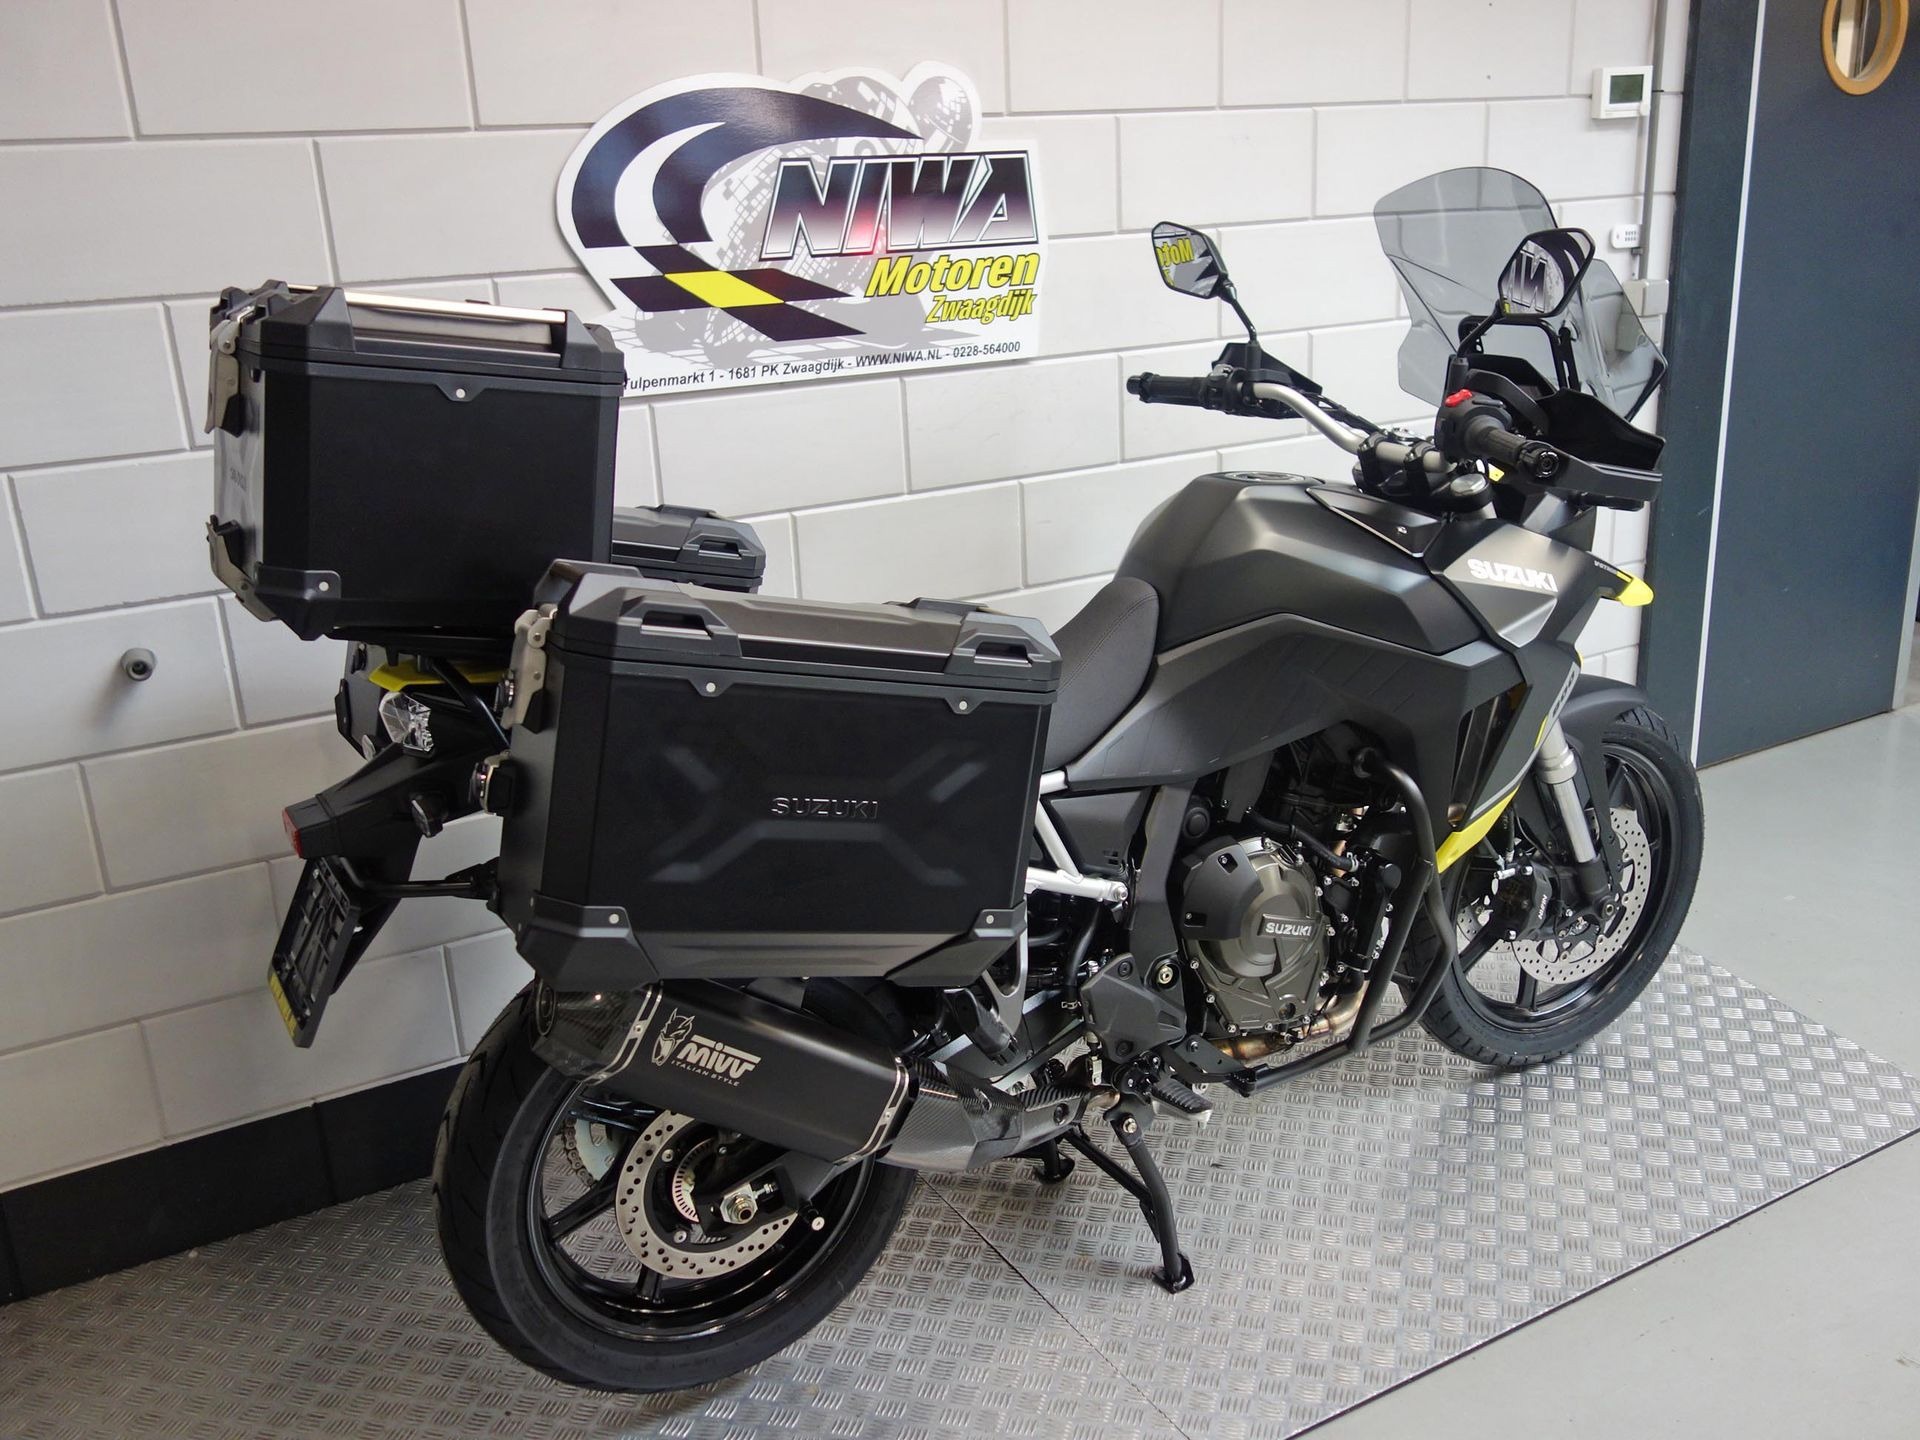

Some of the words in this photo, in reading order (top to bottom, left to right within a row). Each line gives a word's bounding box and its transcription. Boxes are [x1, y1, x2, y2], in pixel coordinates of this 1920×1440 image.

[759, 150, 1039, 261] NIWA
[864, 252, 1040, 298] Motoren
[925, 289, 1037, 324] Zwaagdijk
[624, 371, 705, 391] Tulpenmarkt
[708, 371, 715, 383] 1
[728, 366, 757, 380] 1681
[761, 363, 779, 377] PK
[783, 358, 845, 375] Zwaagdijk
[855, 349, 942, 367] WWW.NIWA.NL
[953, 341, 1021, 358] 0228-564000
[1467, 558, 1559, 592] SUZUKI
[770, 797, 879, 818] SUZUKI
[1265, 922, 1312, 936] SUZUKI
[671, 1060, 709, 1076] ITALIAN
[711, 1073, 741, 1087] STYLE
